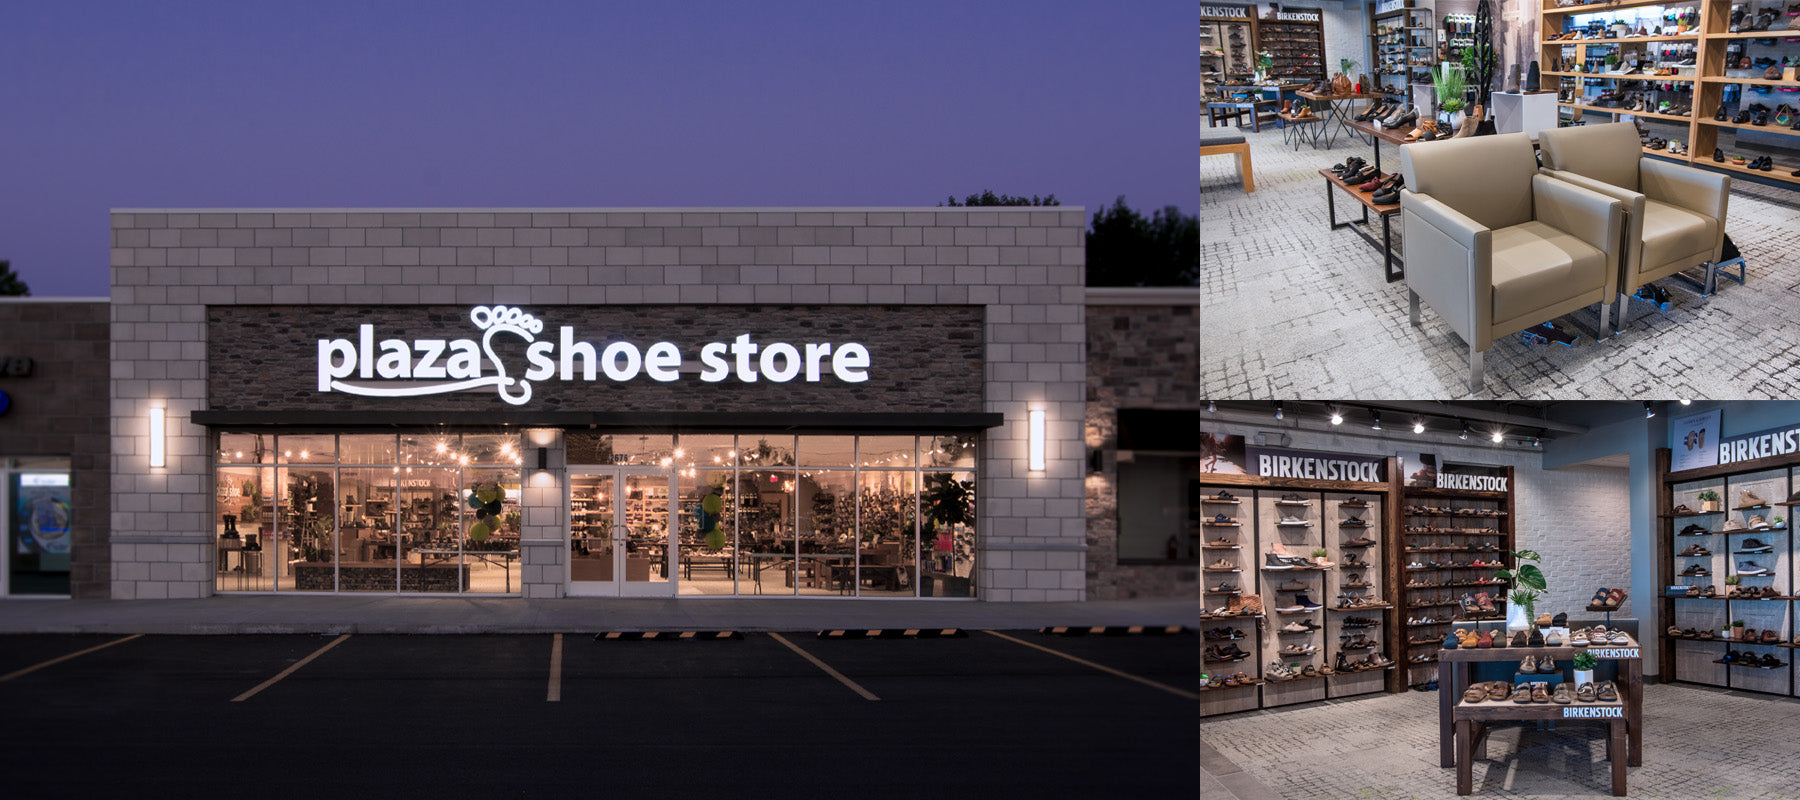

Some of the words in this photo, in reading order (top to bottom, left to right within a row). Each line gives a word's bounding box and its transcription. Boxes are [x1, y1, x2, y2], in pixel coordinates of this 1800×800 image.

[1277, 12, 1320, 22] BIRKENSTOCK
[318, 324, 481, 392] plaza
[525, 326, 681, 382] shoe
[699, 334, 870, 382] store
[1259, 454, 1380, 483] BIRKENSTOCK
[1436, 472, 1508, 492] BIRKENSTOCK
[1587, 648, 1640, 658] BIRKENSTOCK
[1563, 706, 1623, 718] BIRKENSTOCK
